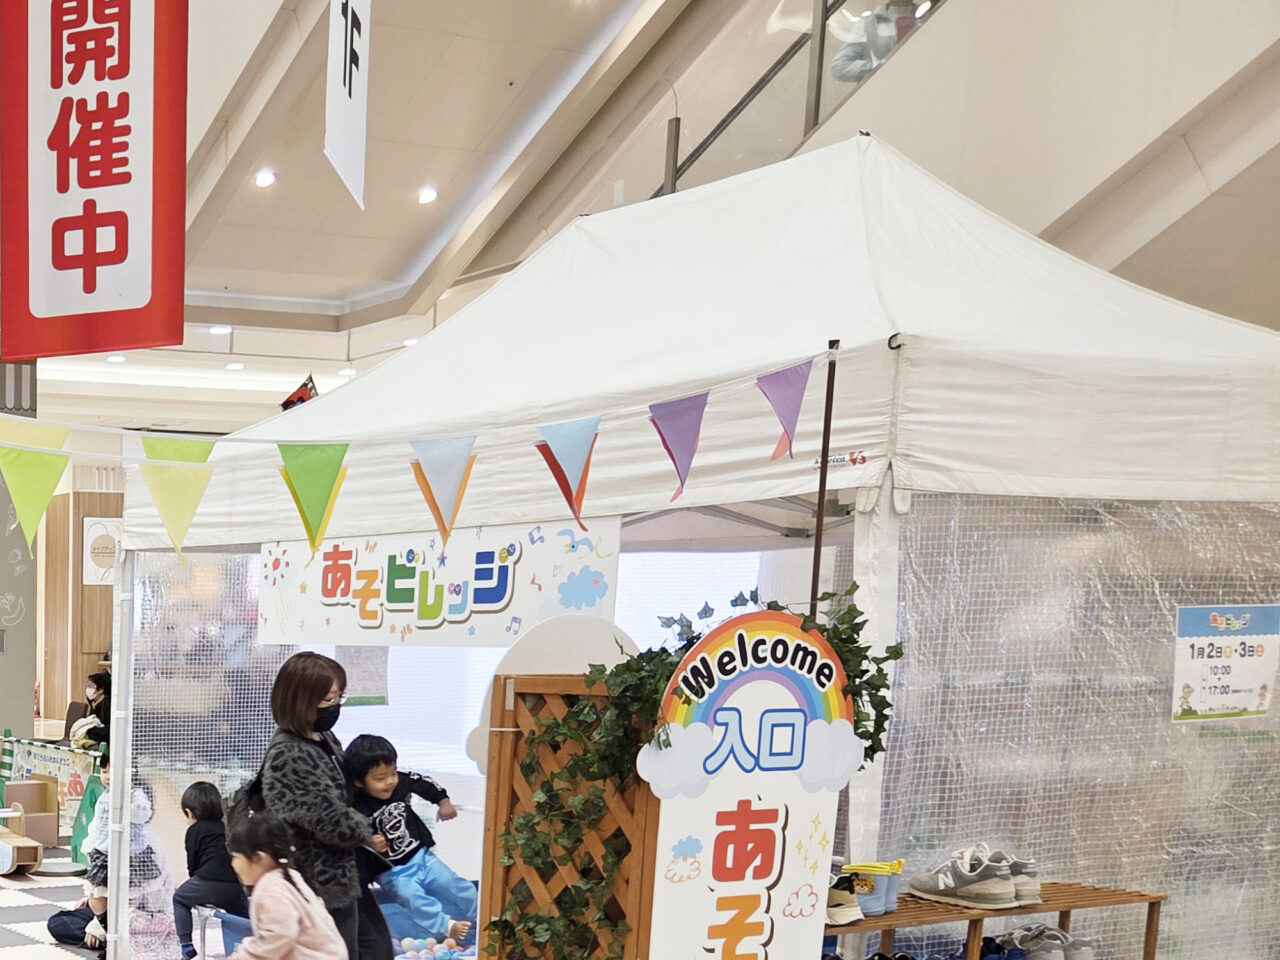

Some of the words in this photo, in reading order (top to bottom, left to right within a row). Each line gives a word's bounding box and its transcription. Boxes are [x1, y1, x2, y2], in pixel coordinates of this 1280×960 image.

[47, 0, 133, 295] 開催中
[321, 543, 518, 622] あそビレッジ
[682, 633, 835, 700] Welcome
[703, 707, 807, 776] 入口
